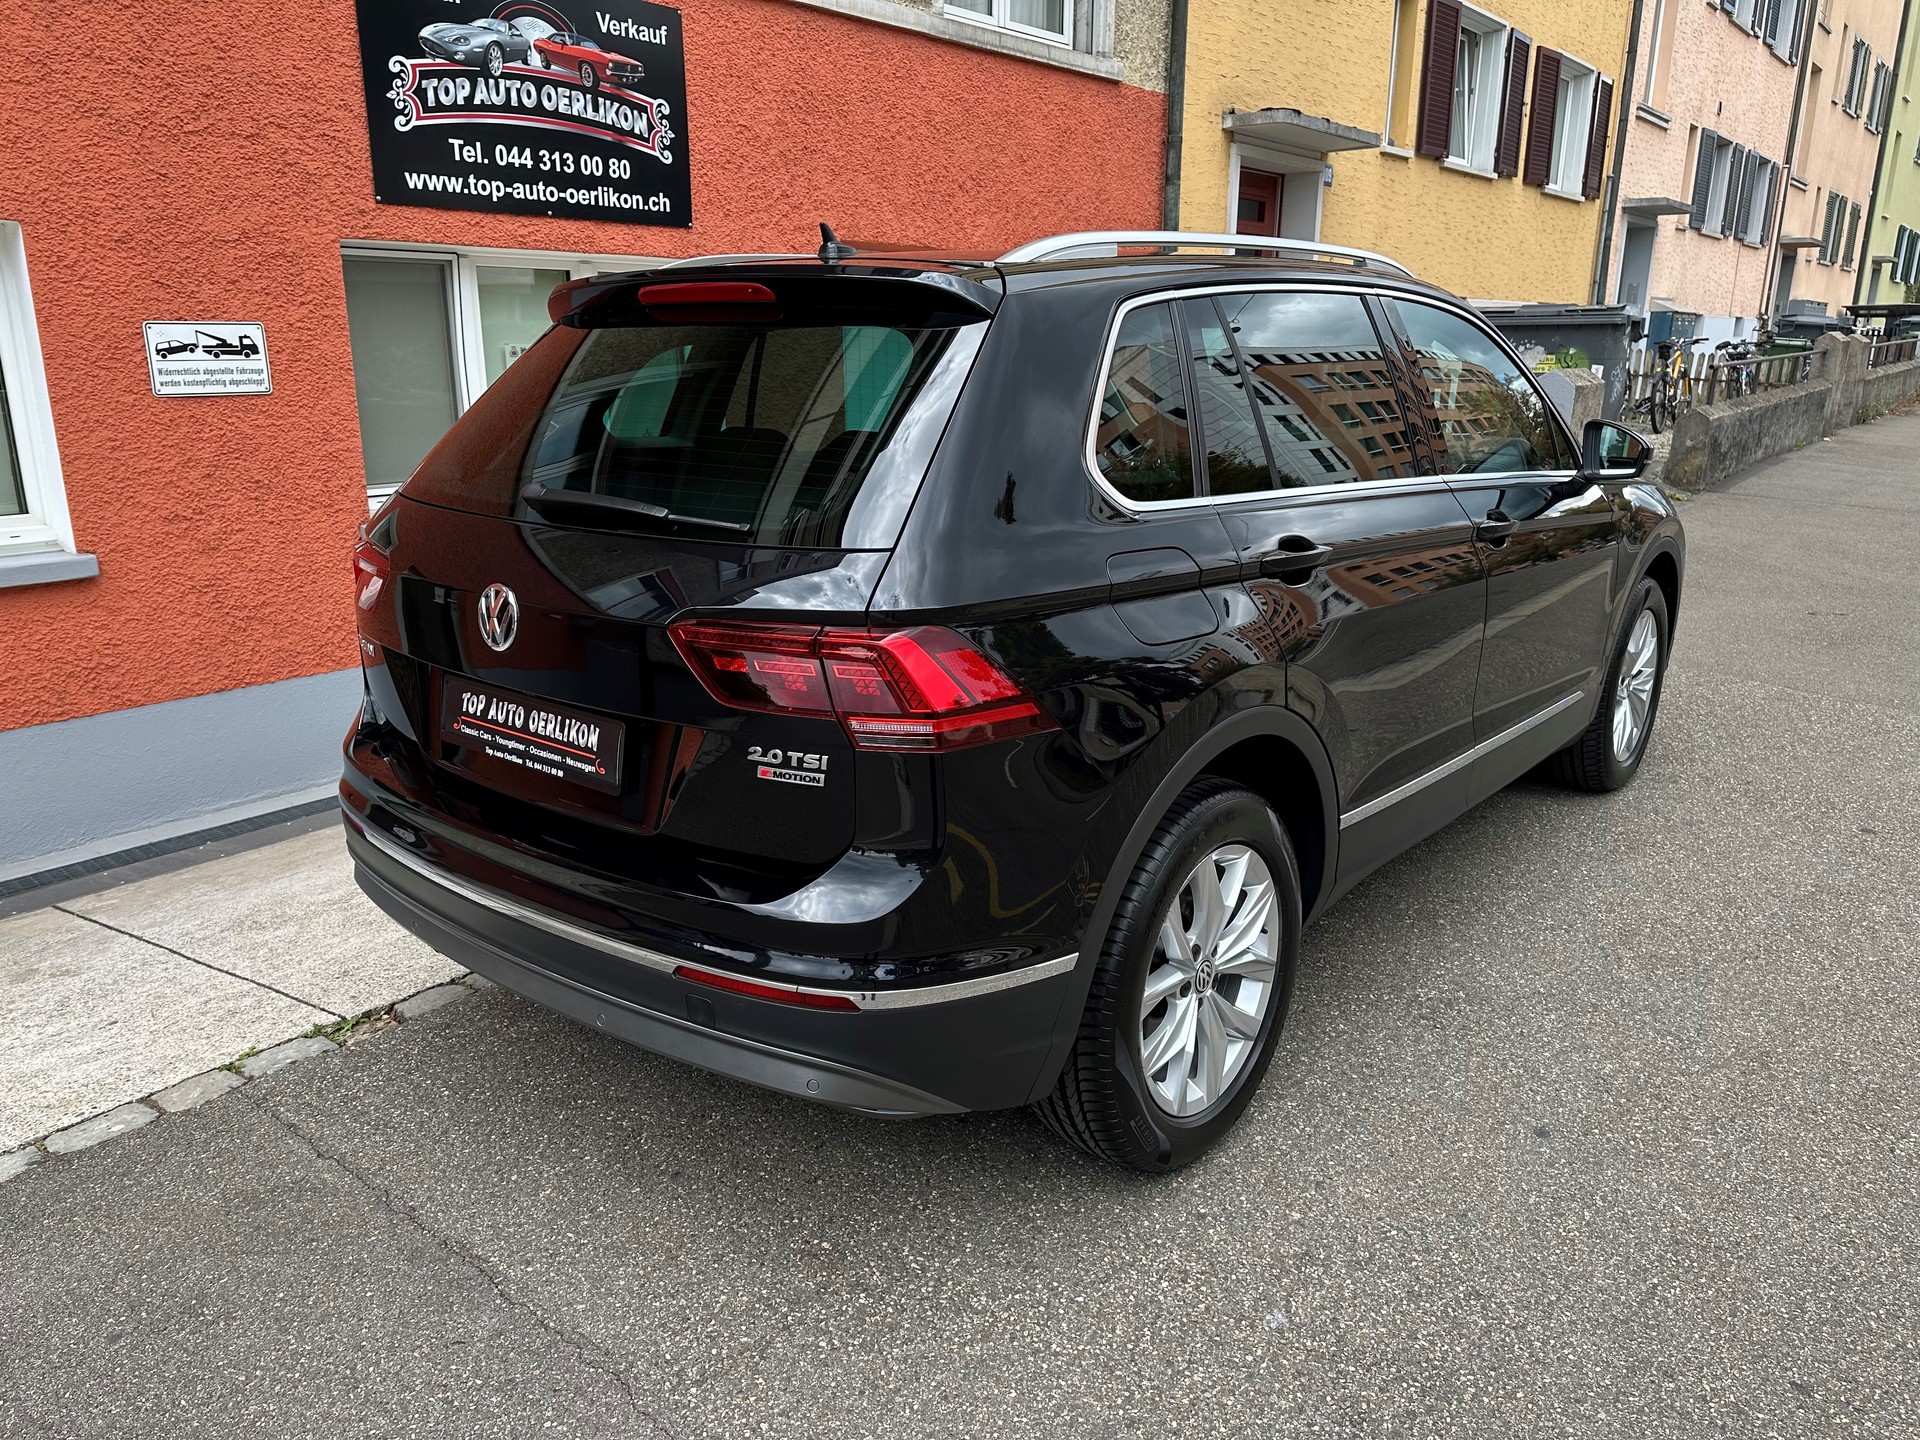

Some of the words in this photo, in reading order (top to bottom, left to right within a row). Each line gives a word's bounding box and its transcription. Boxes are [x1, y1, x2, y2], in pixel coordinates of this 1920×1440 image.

[596, 11, 667, 45] Verkauf
[422, 78, 471, 107] TOP
[474, 78, 537, 108] AUTO
[540, 85, 649, 137] OERLIKON
[449, 138, 488, 164] Tel.
[496, 145, 533, 169] 044
[538, 150, 574, 173] 313
[580, 155, 602, 176] 00
[608, 158, 630, 180] 80
[404, 171, 670, 212] www.top-auto-oerlikon.ch
[157, 368, 200, 376] Widerrechtlich
[203, 367, 234, 376] abgestellte
[236, 367, 264, 376] Fahrzeuge
[159, 379, 181, 387] werden
[184, 379, 226, 387] kostenpflichtig
[229, 378, 265, 387] abgeschleppt
[462, 692, 485, 716] TOP
[488, 698, 524, 728] AUTO
[529, 710, 599, 751] OERLIKON
[461, 724, 479, 738] Classic
[480, 730, 492, 741] Cars
[496, 735, 525, 751] Youngtimer
[530, 745, 562, 762] Occasionen
[566, 757, 595, 772] Neuwagen
[787, 751, 829, 770] TSI
